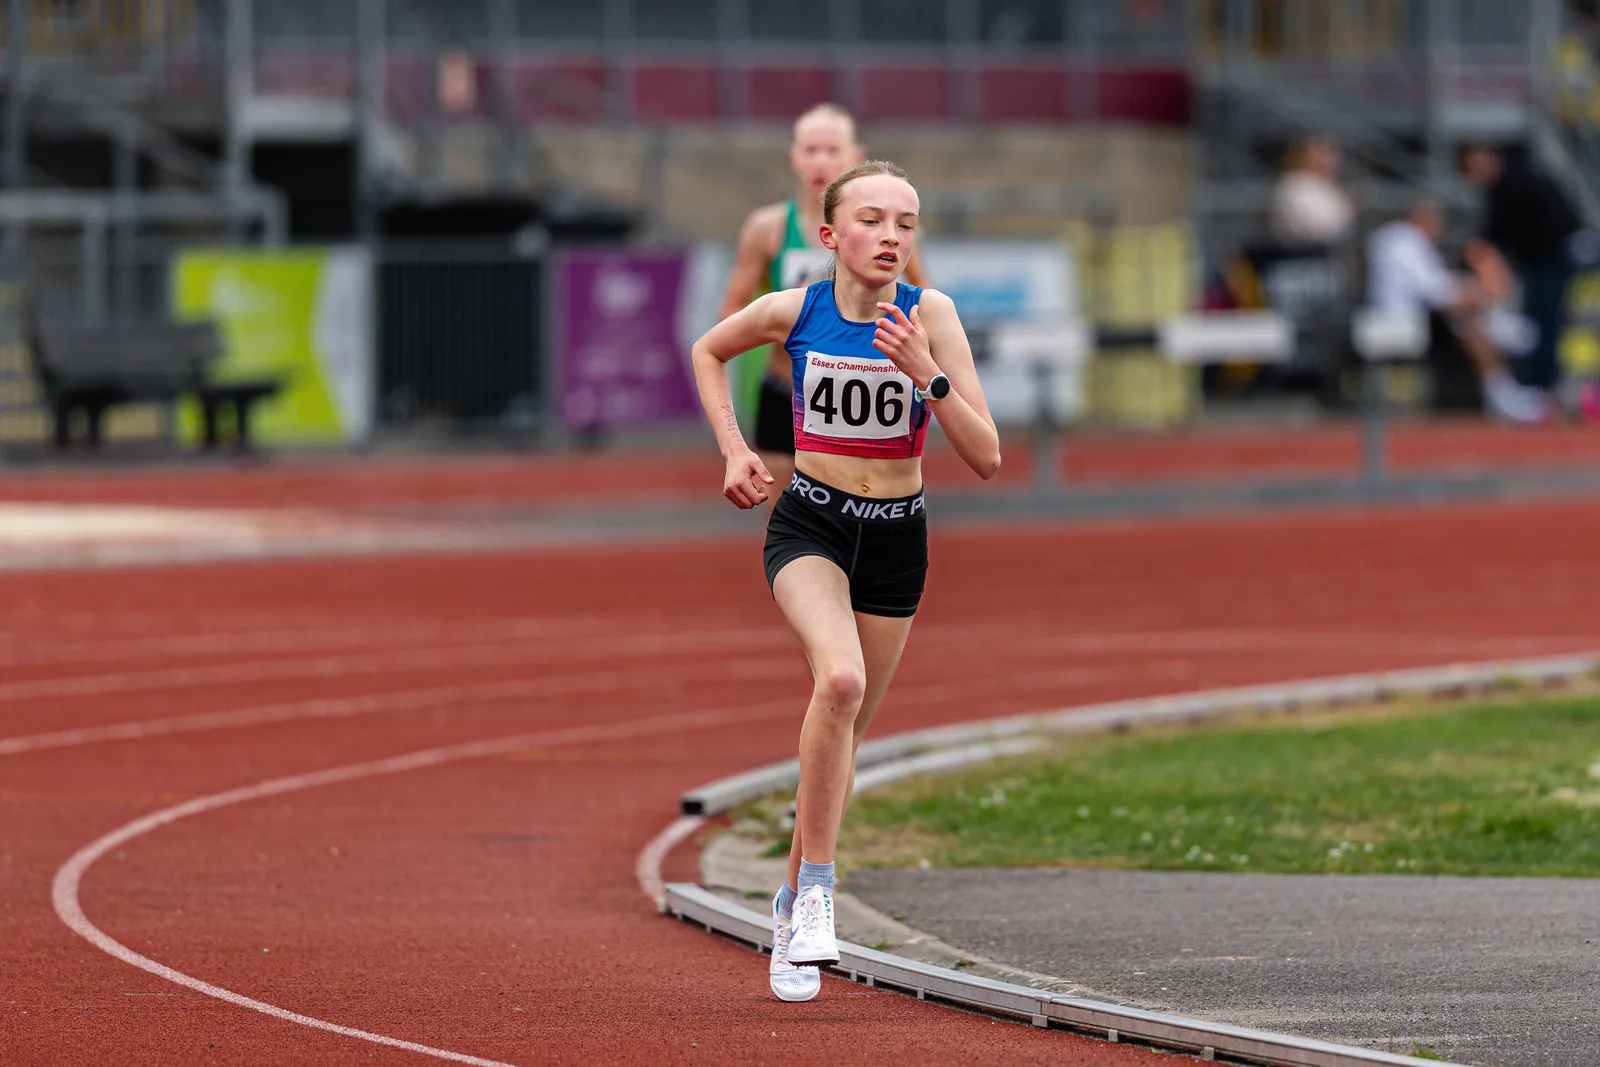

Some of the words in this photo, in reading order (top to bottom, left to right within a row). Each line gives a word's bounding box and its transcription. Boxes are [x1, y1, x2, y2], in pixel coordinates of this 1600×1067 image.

[811, 358, 835, 369] Essex
[810, 377, 904, 427] 406
[841, 499, 908, 519] NIKE
